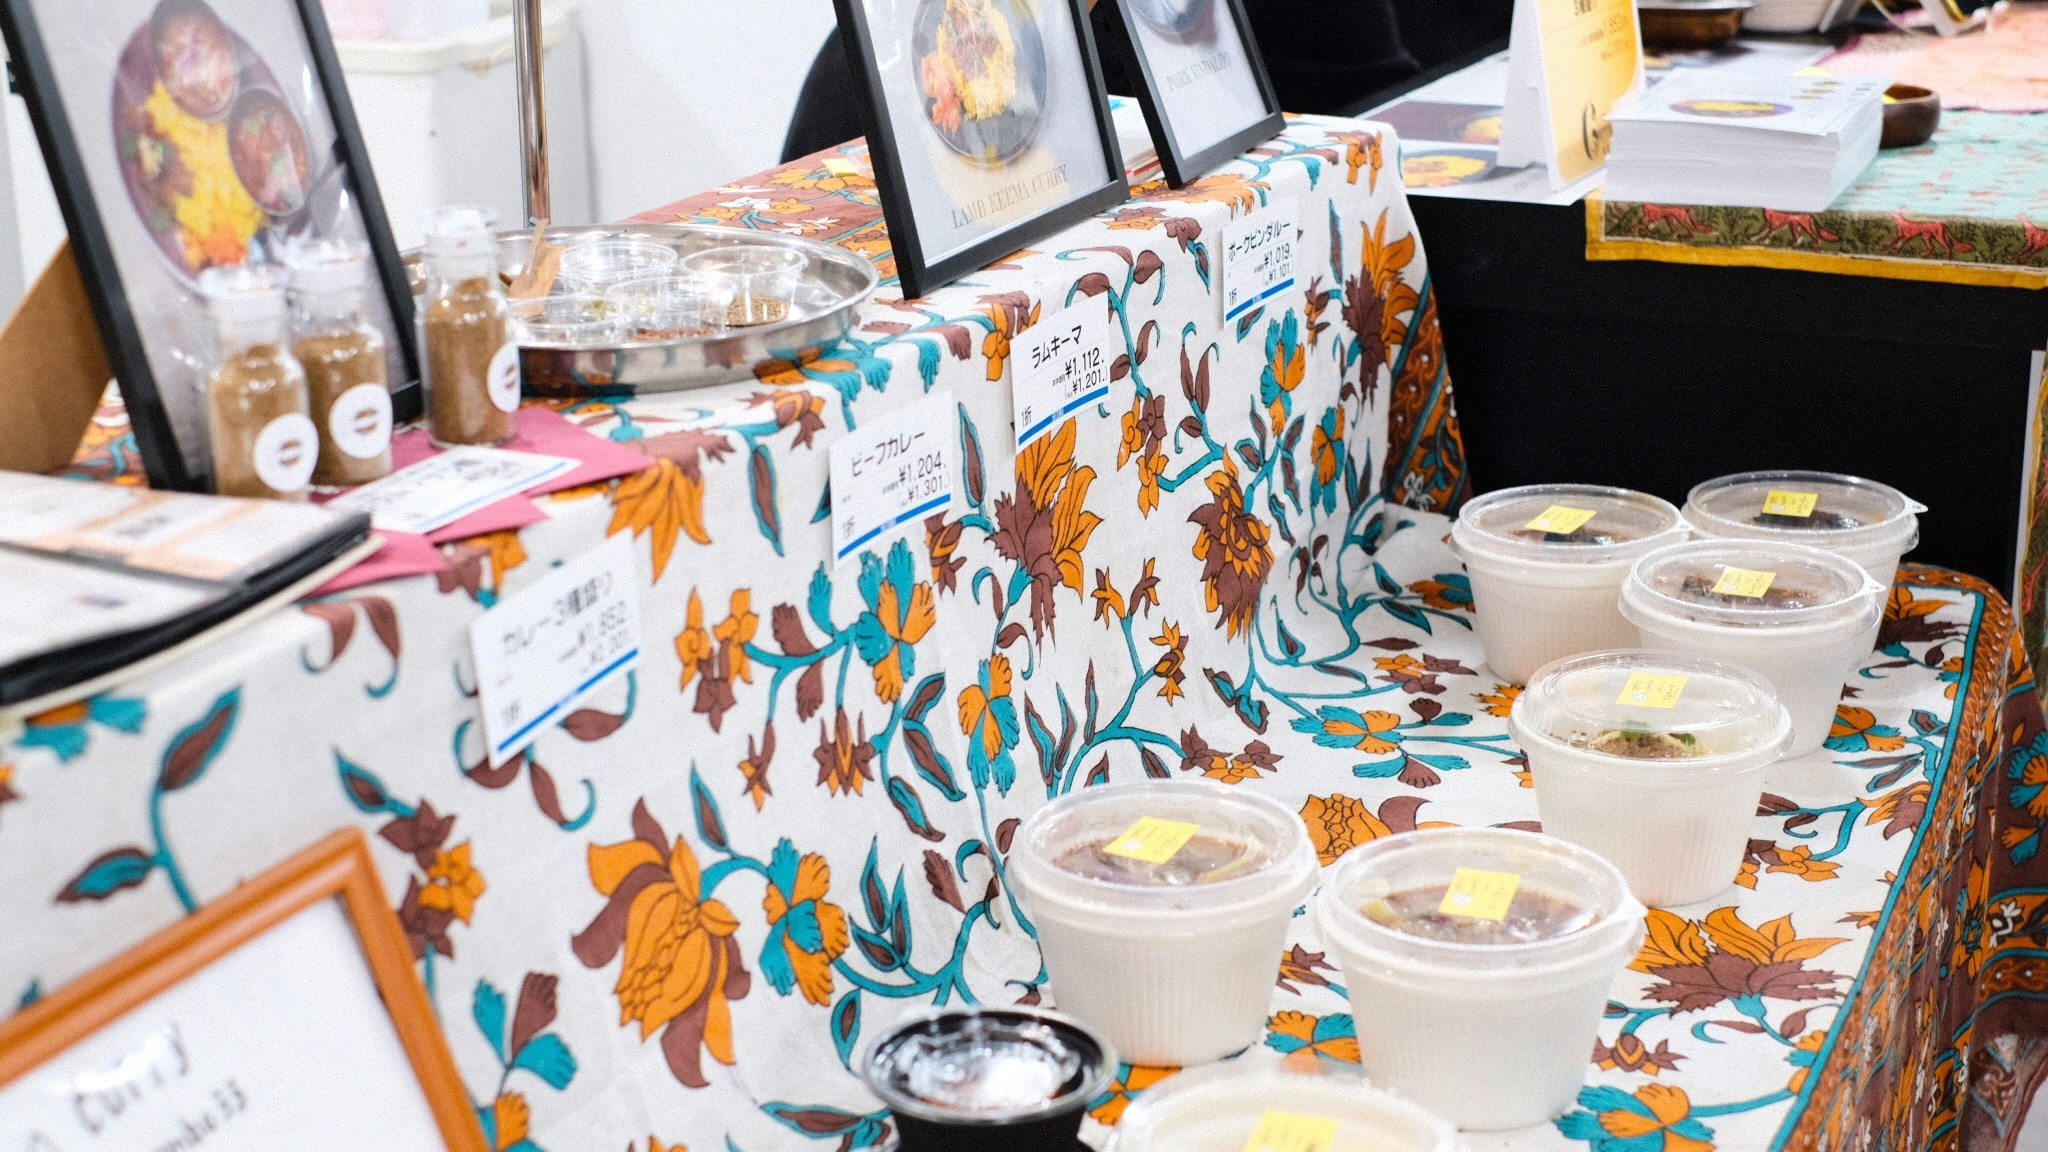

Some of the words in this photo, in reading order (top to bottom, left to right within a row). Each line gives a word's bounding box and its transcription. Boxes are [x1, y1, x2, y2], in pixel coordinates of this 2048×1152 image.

[952, 200, 987, 229] LAMB
[988, 184, 1031, 216] KEEMA
[1031, 164, 1071, 194] CURRY
[1229, 221, 1290, 262] ポークビンダルー
[1032, 325, 1082, 369] ラムキーマ
[852, 432, 925, 477] ビーフカレー
